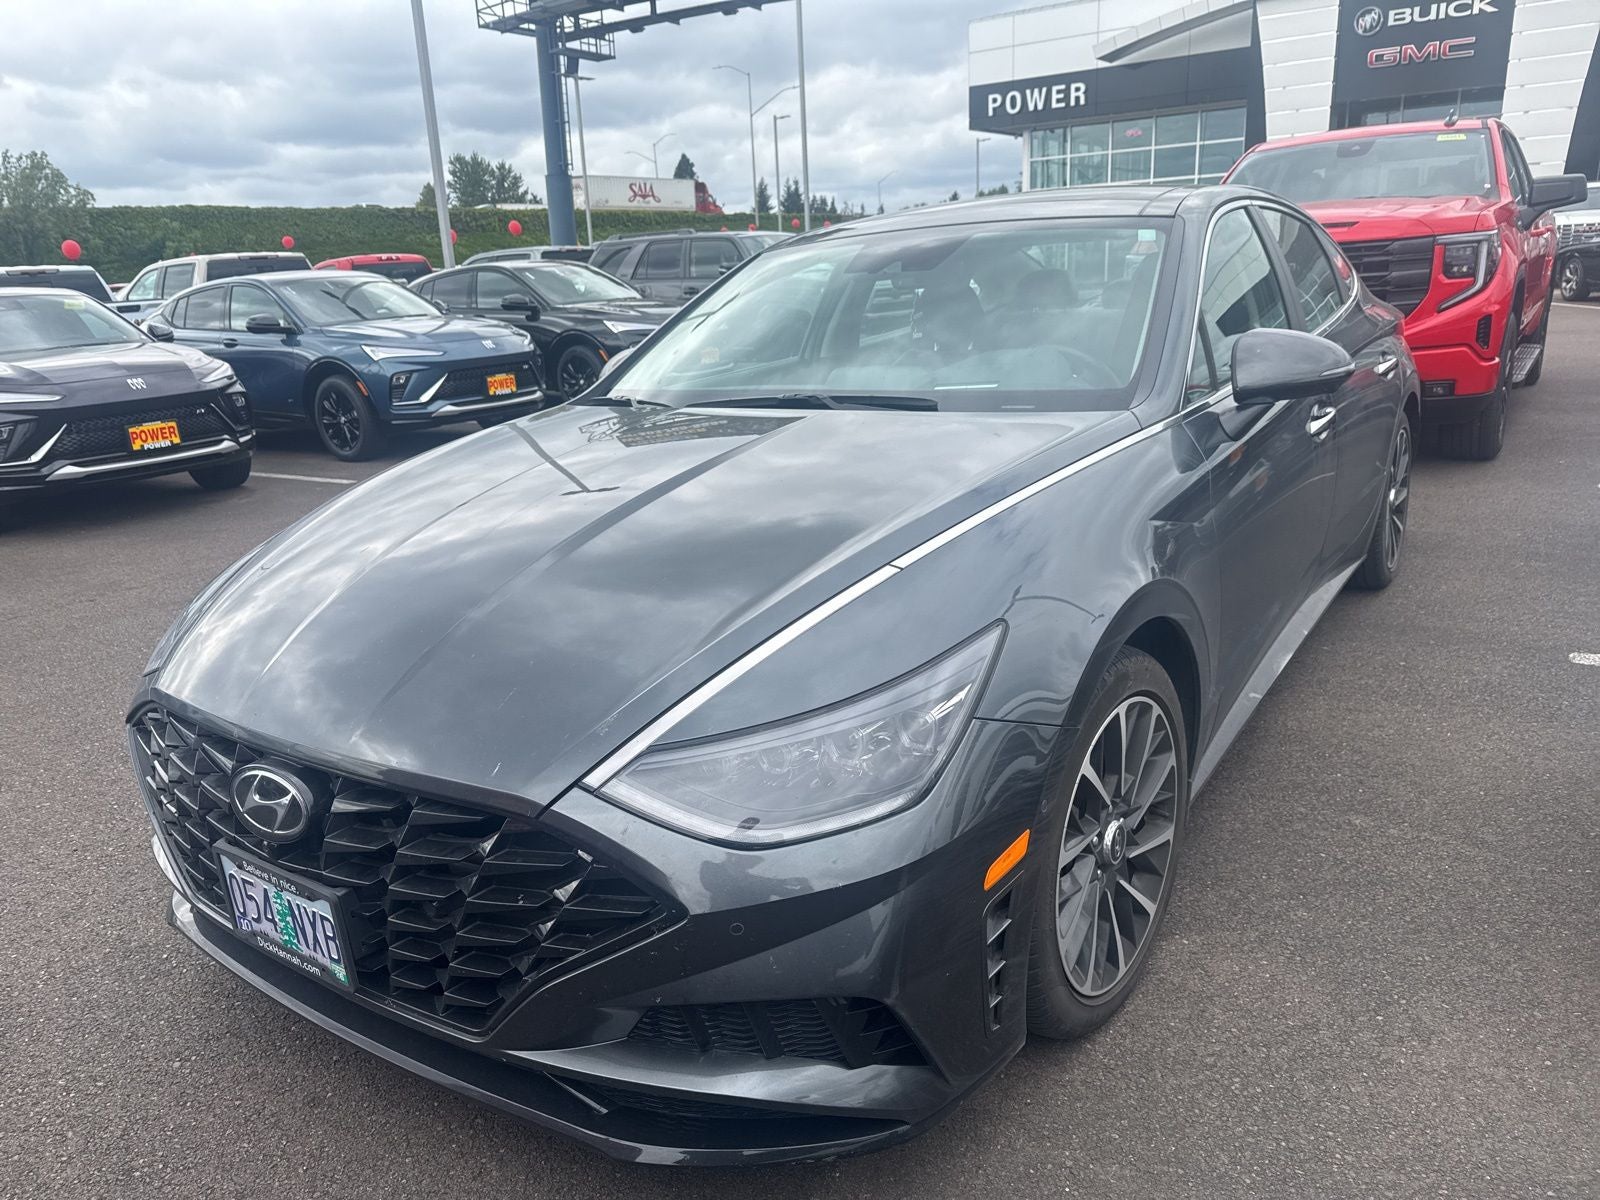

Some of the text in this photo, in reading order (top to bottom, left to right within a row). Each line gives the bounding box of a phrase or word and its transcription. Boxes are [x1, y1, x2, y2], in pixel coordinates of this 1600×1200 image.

[1387, 0, 1499, 27] BUICK
[1367, 36, 1476, 69] GMC
[987, 82, 1087, 117] POWER
[489, 377, 515, 391] POWER
[130, 425, 178, 444] POWER
[143, 440, 172, 450] POWER
[242, 861, 299, 895] Believe in nice.
[285, 896, 342, 964] NXB
[257, 936, 321, 977] DickHannah.com
